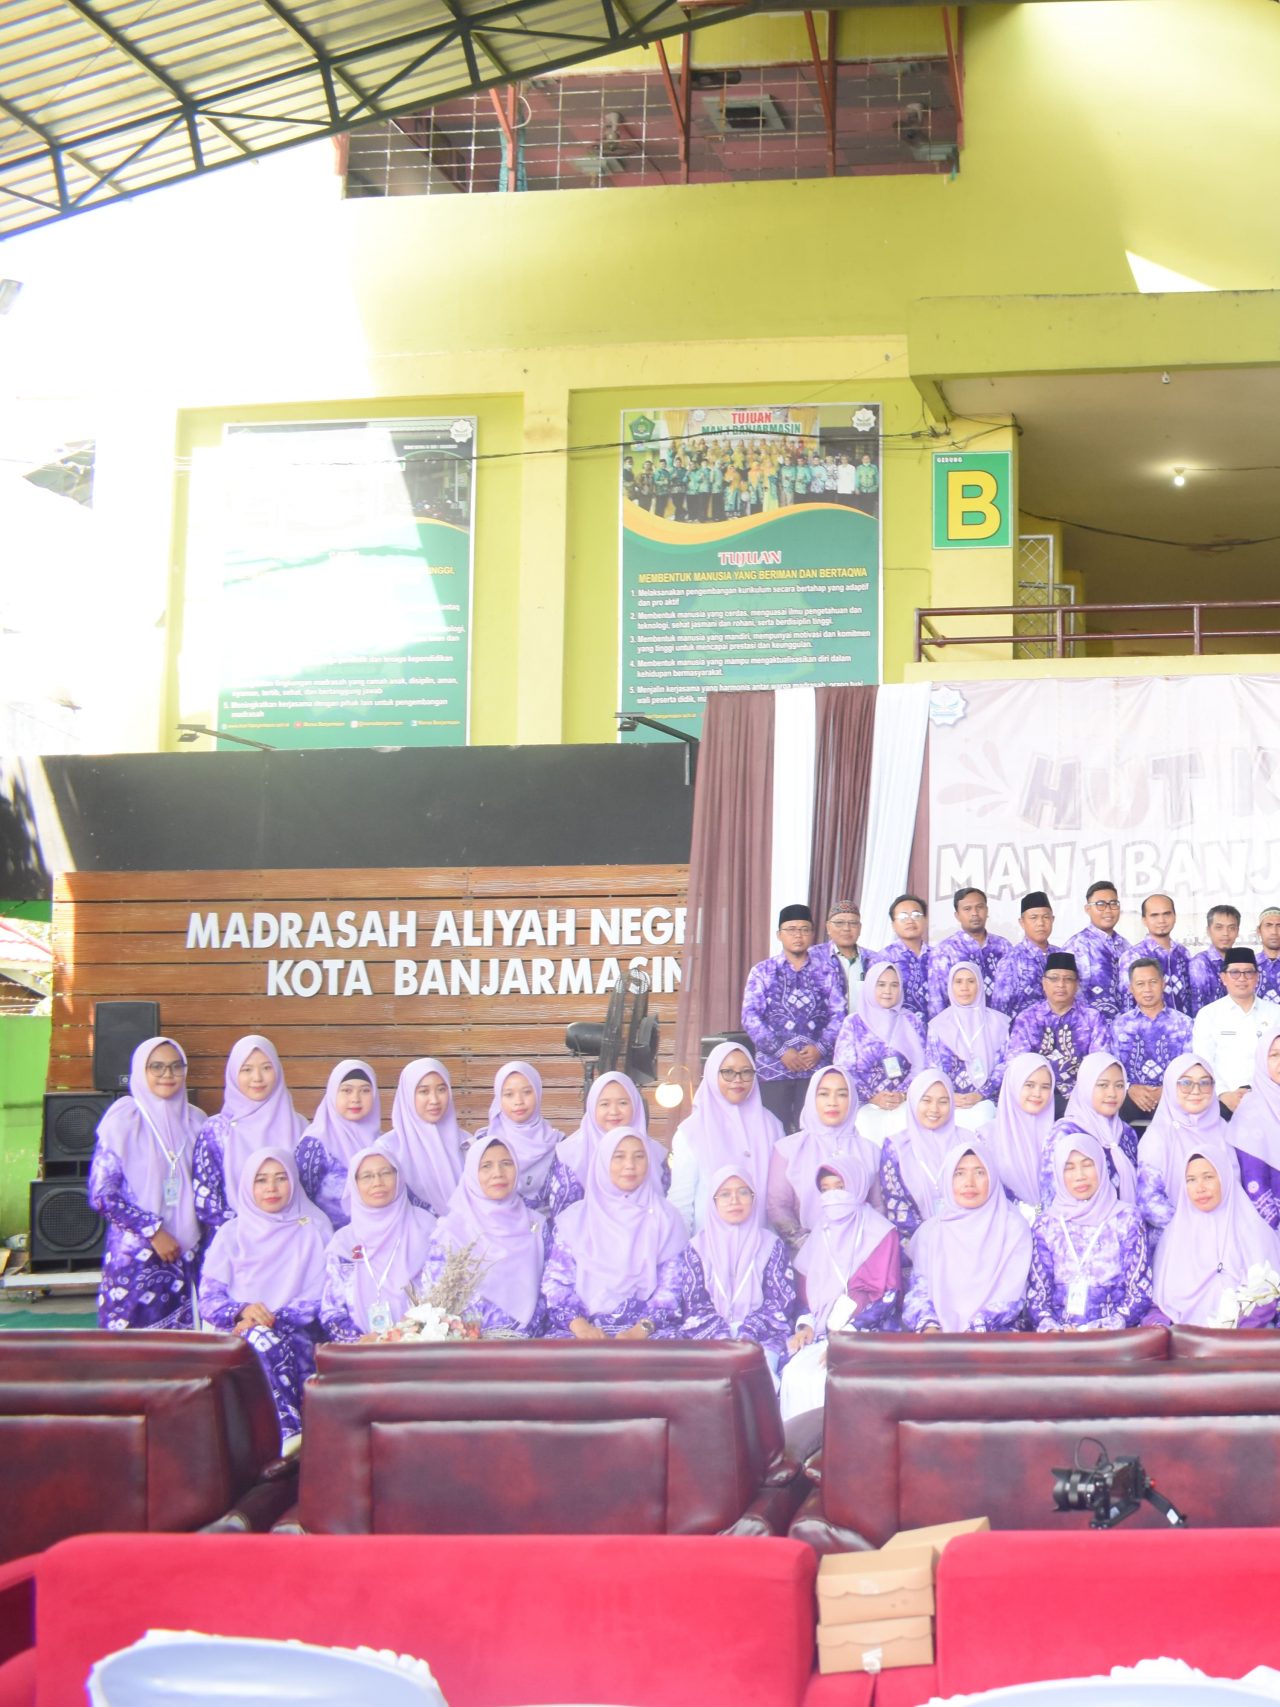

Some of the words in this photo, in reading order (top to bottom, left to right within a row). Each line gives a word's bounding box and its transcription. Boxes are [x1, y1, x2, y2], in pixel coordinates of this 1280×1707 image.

[731, 411, 772, 424] TUJUAN
[702, 426, 724, 435] MAN
[732, 423, 801, 436] BANJARMASIN
[947, 469, 1002, 541] B
[718, 550, 782, 567] TUJUAN
[638, 572, 692, 583] MEMBENTUK
[694, 571, 732, 582] MANUSIA
[734, 570, 757, 580] YANG
[759, 569, 798, 579] BERIMAN
[799, 569, 818, 578] DAN
[819, 568, 868, 578] BERTAQWA
[796, 584, 827, 593] bertahap
[827, 585, 845, 593] yang
[849, 606, 863, 614] dan
[823, 630, 836, 638] dan
[1017, 745, 1206, 832] HUT
[934, 840, 1077, 901] MAN
[1081, 839, 1113, 893] 1
[186, 910, 417, 950] MADRASAH
[430, 908, 577, 948] ALIYAH
[266, 959, 373, 998] KOTA
[394, 956, 692, 997] BANJARMASIN
